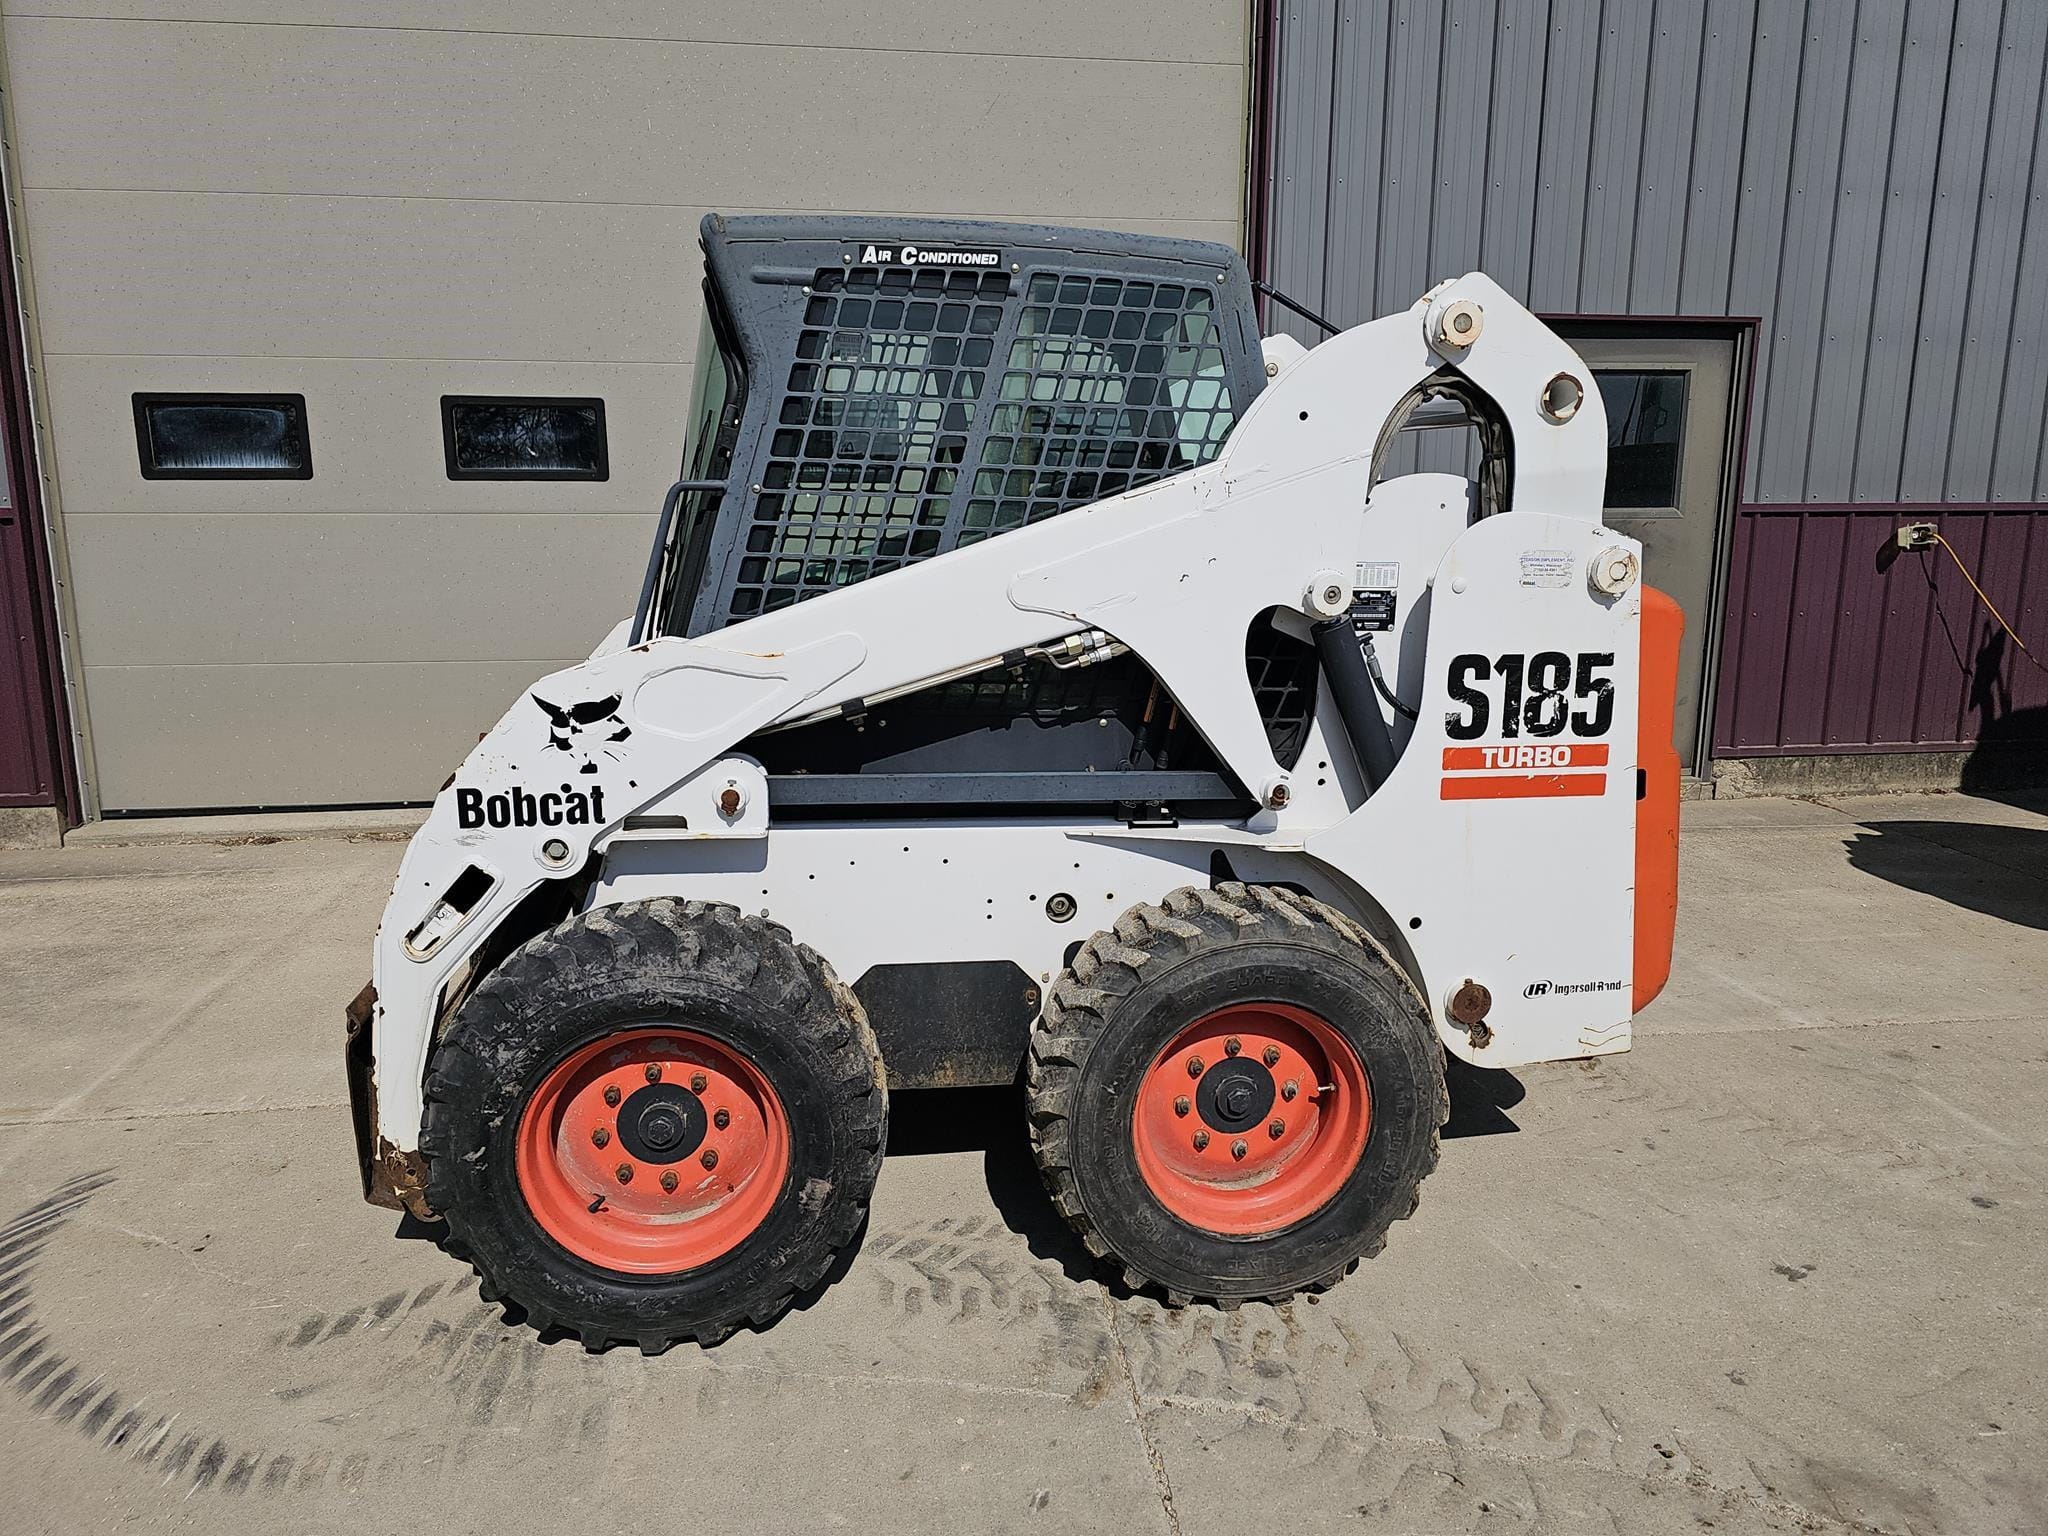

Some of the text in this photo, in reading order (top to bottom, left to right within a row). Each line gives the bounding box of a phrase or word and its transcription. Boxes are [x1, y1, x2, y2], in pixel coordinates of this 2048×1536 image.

[1444, 651, 1615, 741] S185
[1482, 746, 1572, 768] TURBO
[456, 784, 606, 829] Bobcat
[1526, 982, 1549, 997] IR
